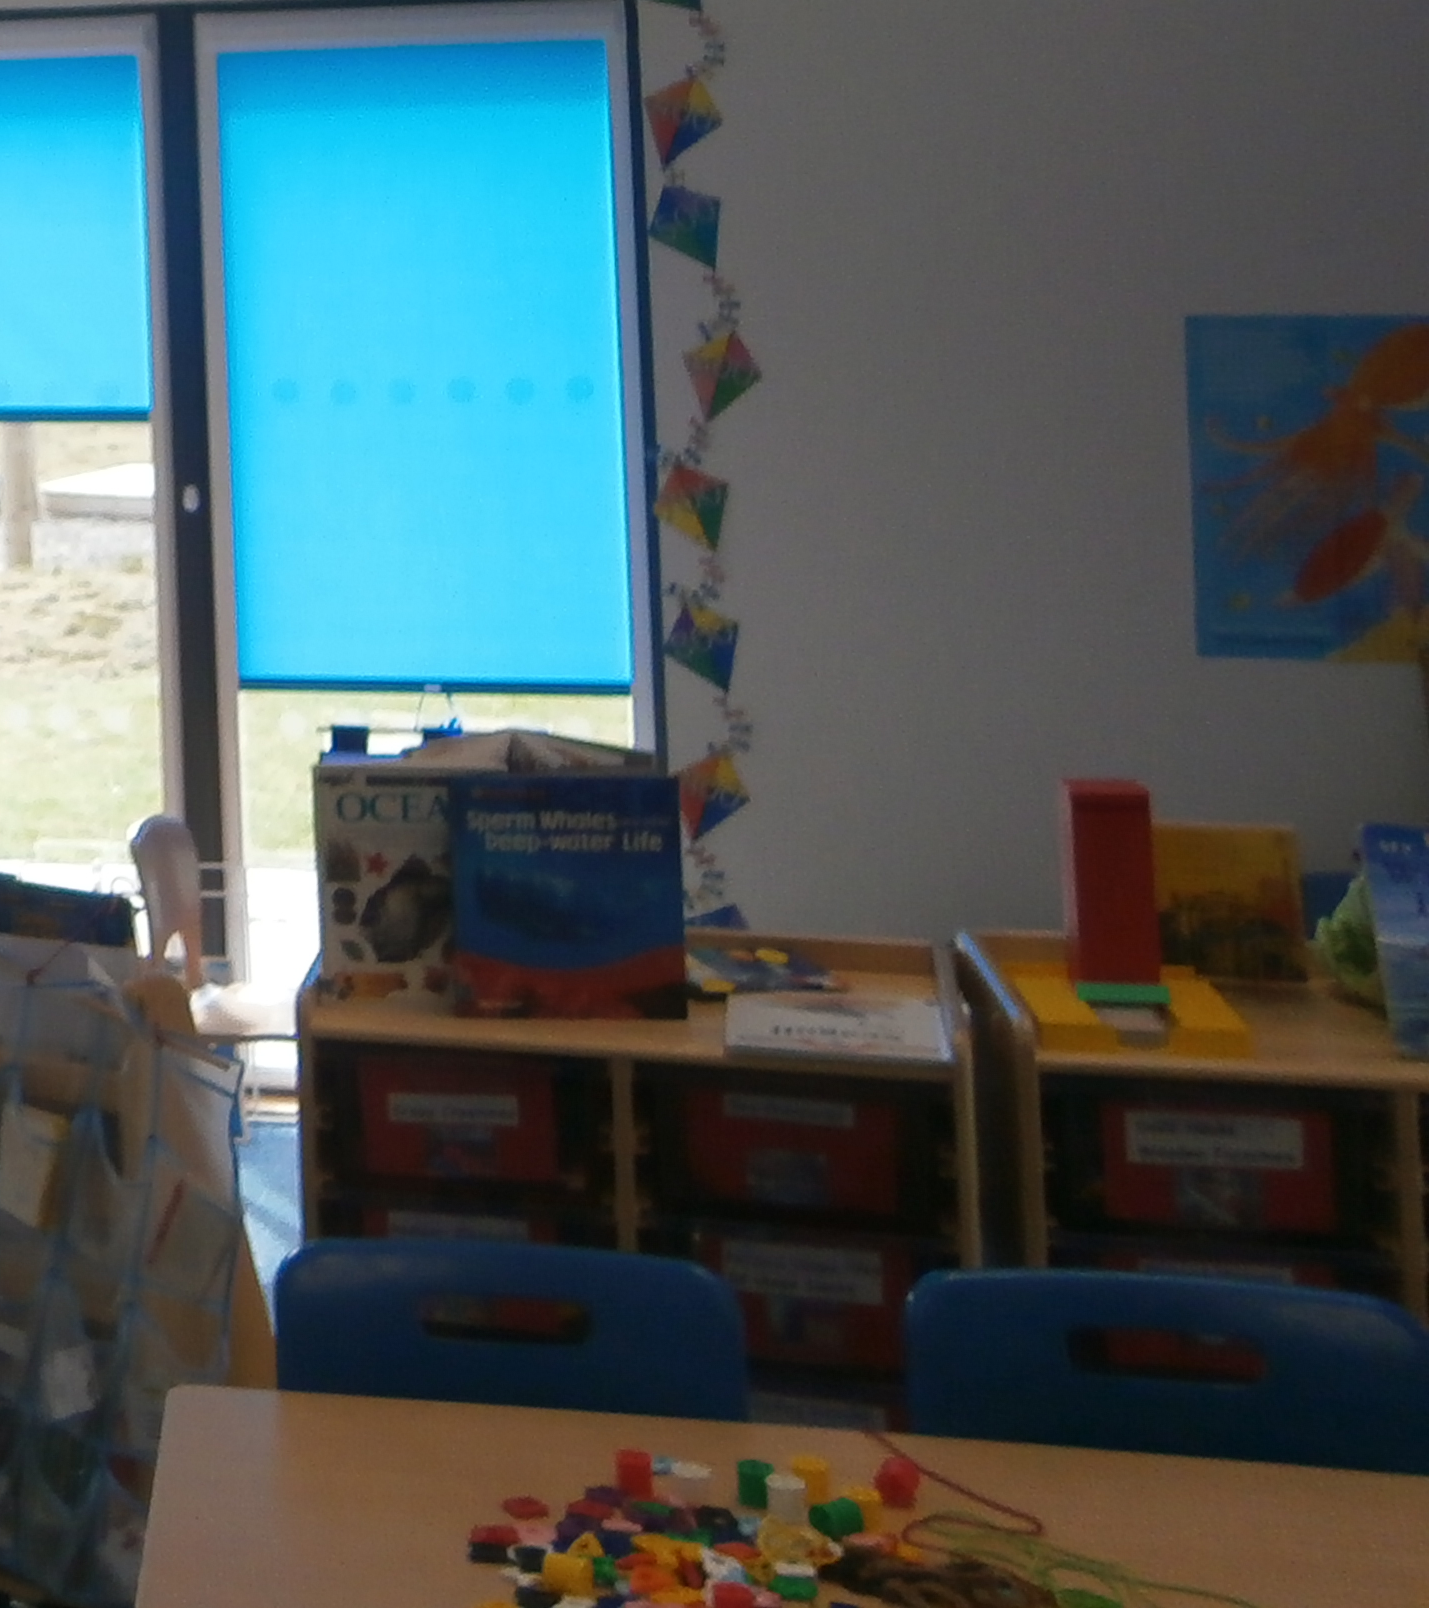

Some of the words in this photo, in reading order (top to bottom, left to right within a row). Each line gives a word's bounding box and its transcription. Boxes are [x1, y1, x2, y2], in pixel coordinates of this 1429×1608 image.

[466, 809, 536, 832] Sperm
[541, 810, 619, 829] Whales
[485, 832, 614, 852] Deep-water
[623, 833, 663, 852] Life
